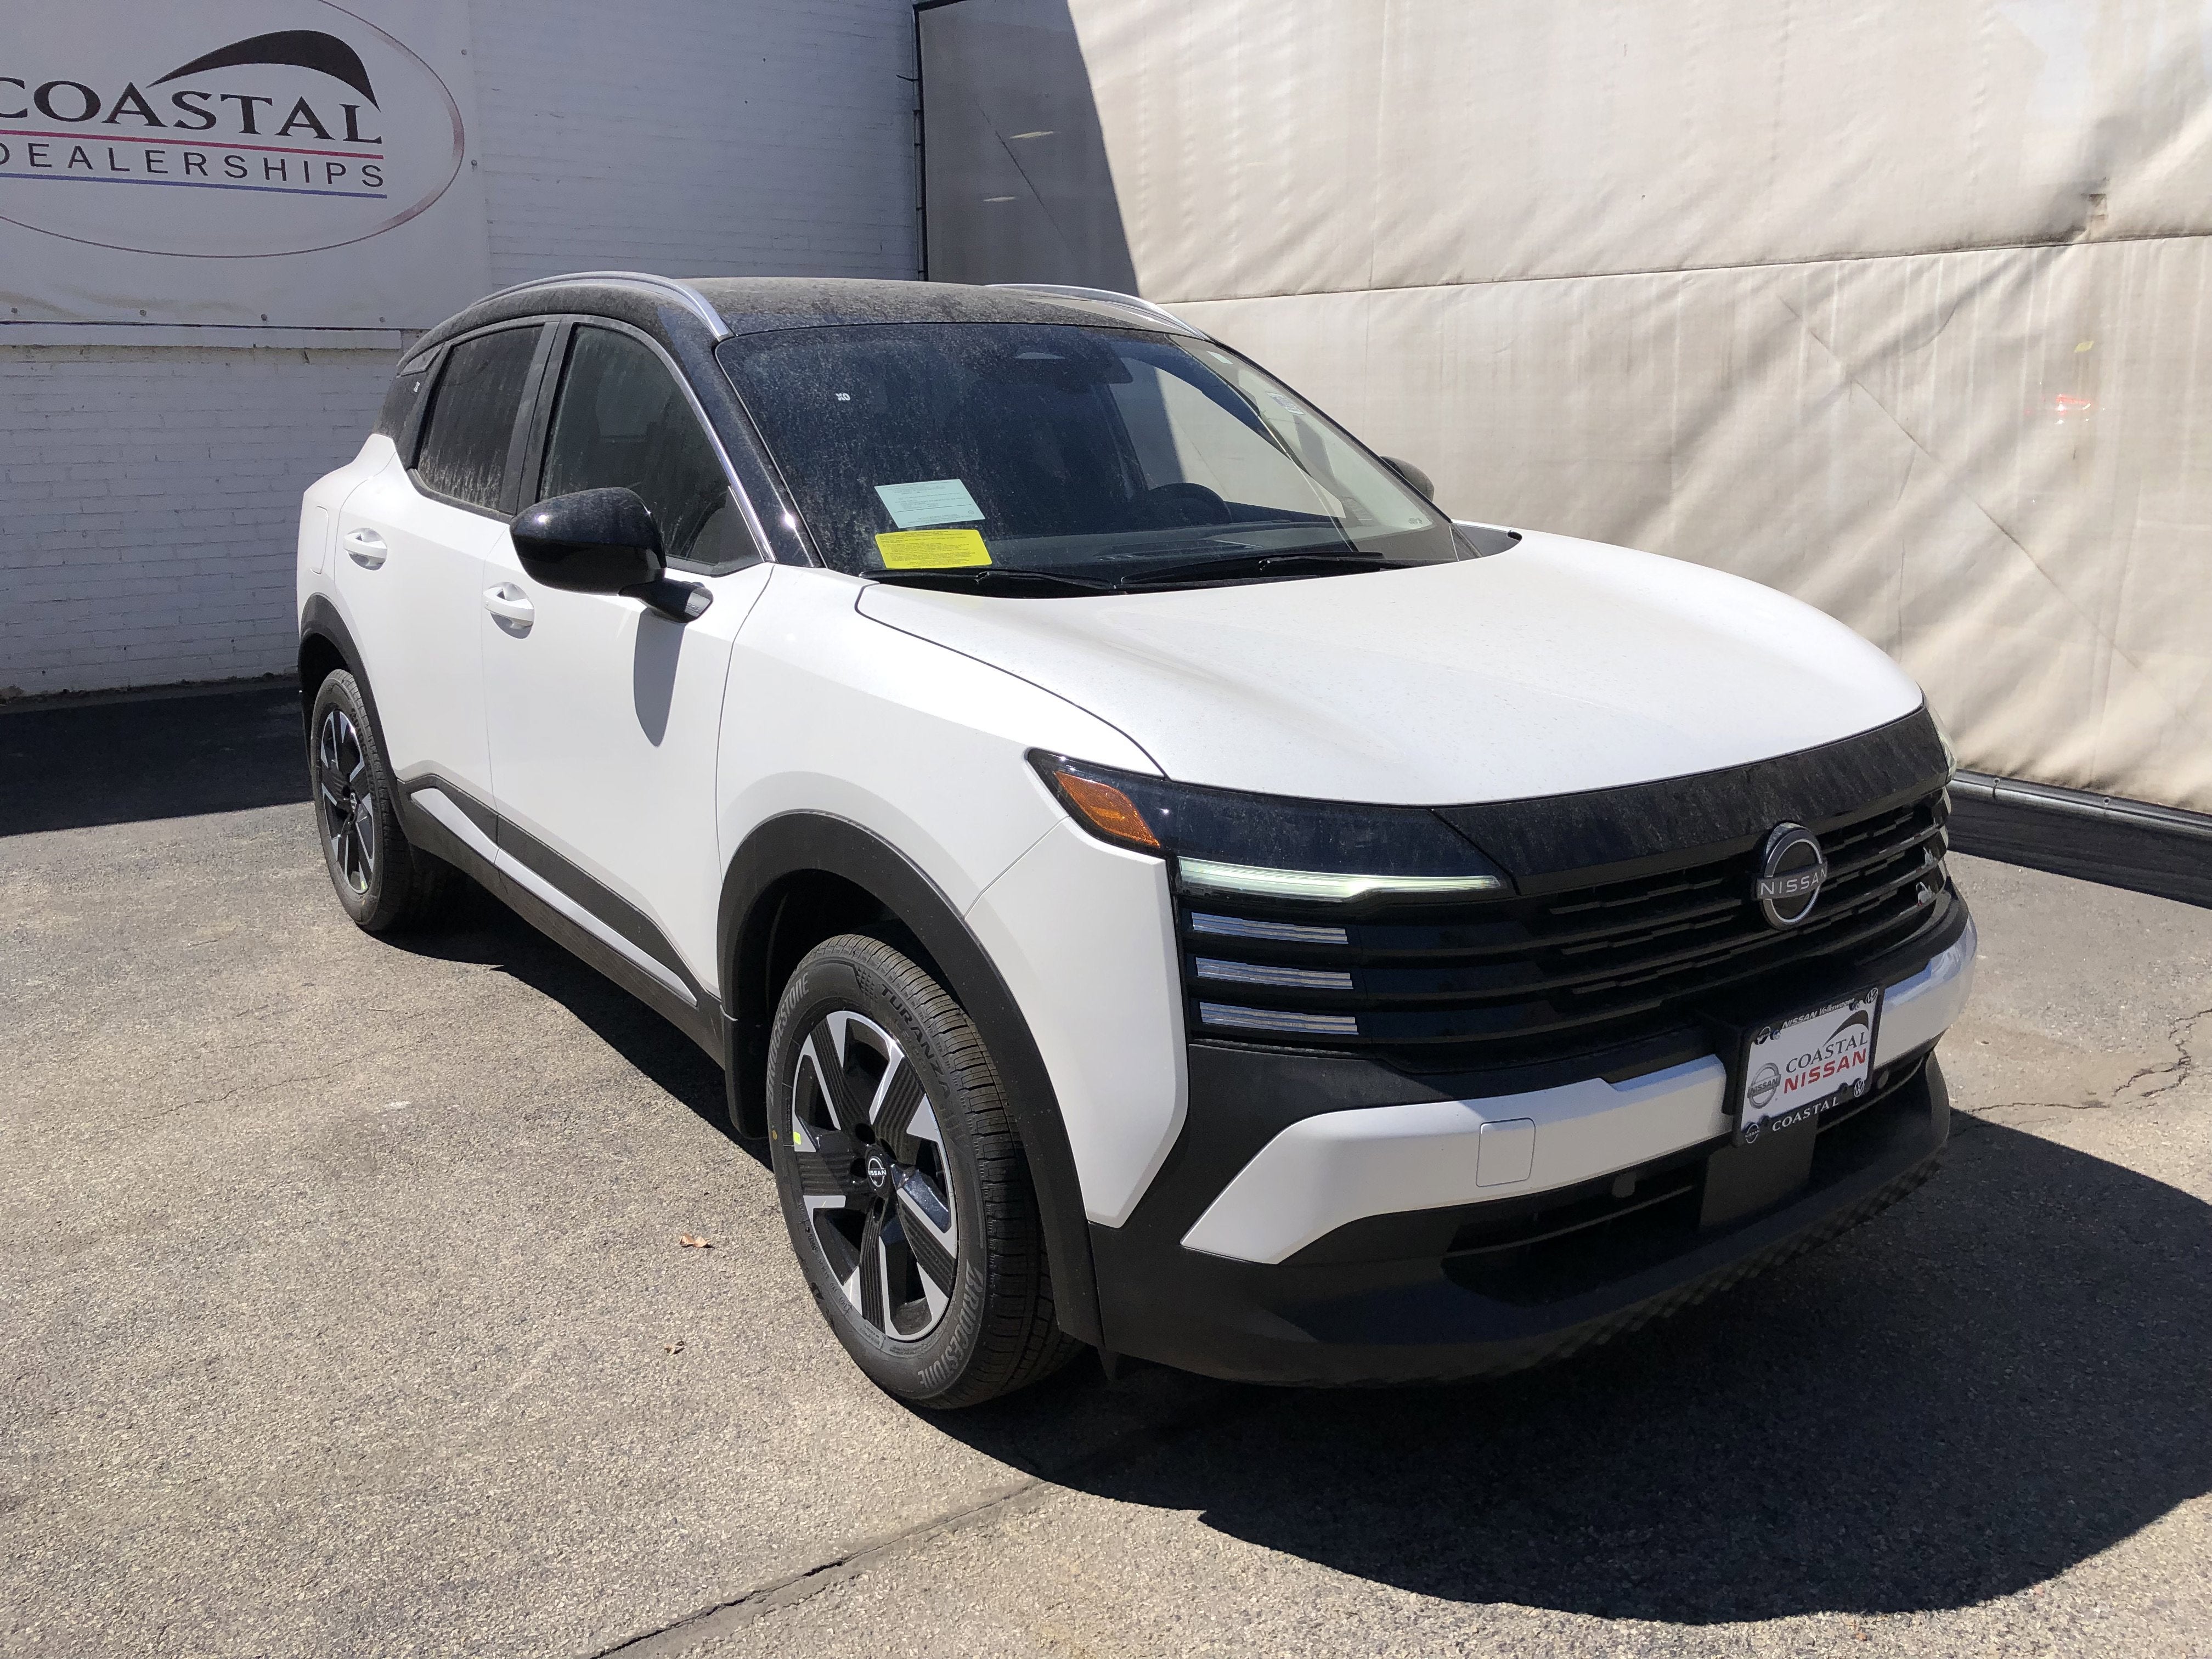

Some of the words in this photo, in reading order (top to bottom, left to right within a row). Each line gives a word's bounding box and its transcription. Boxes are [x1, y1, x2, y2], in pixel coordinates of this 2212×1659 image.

[1760, 868, 1827, 895] NISSAN
[1782, 1011, 1818, 1029] NISSAN
[881, 983, 951, 1098] TURANZA
[1786, 1031, 1867, 1073] COASTAL
[1749, 1077, 1779, 1094] NISSAN
[1784, 1048, 1867, 1094] NISSAN
[1772, 1097, 1839, 1132] COASTAL
[917, 1259, 984, 1388] BRIDGESTONE
